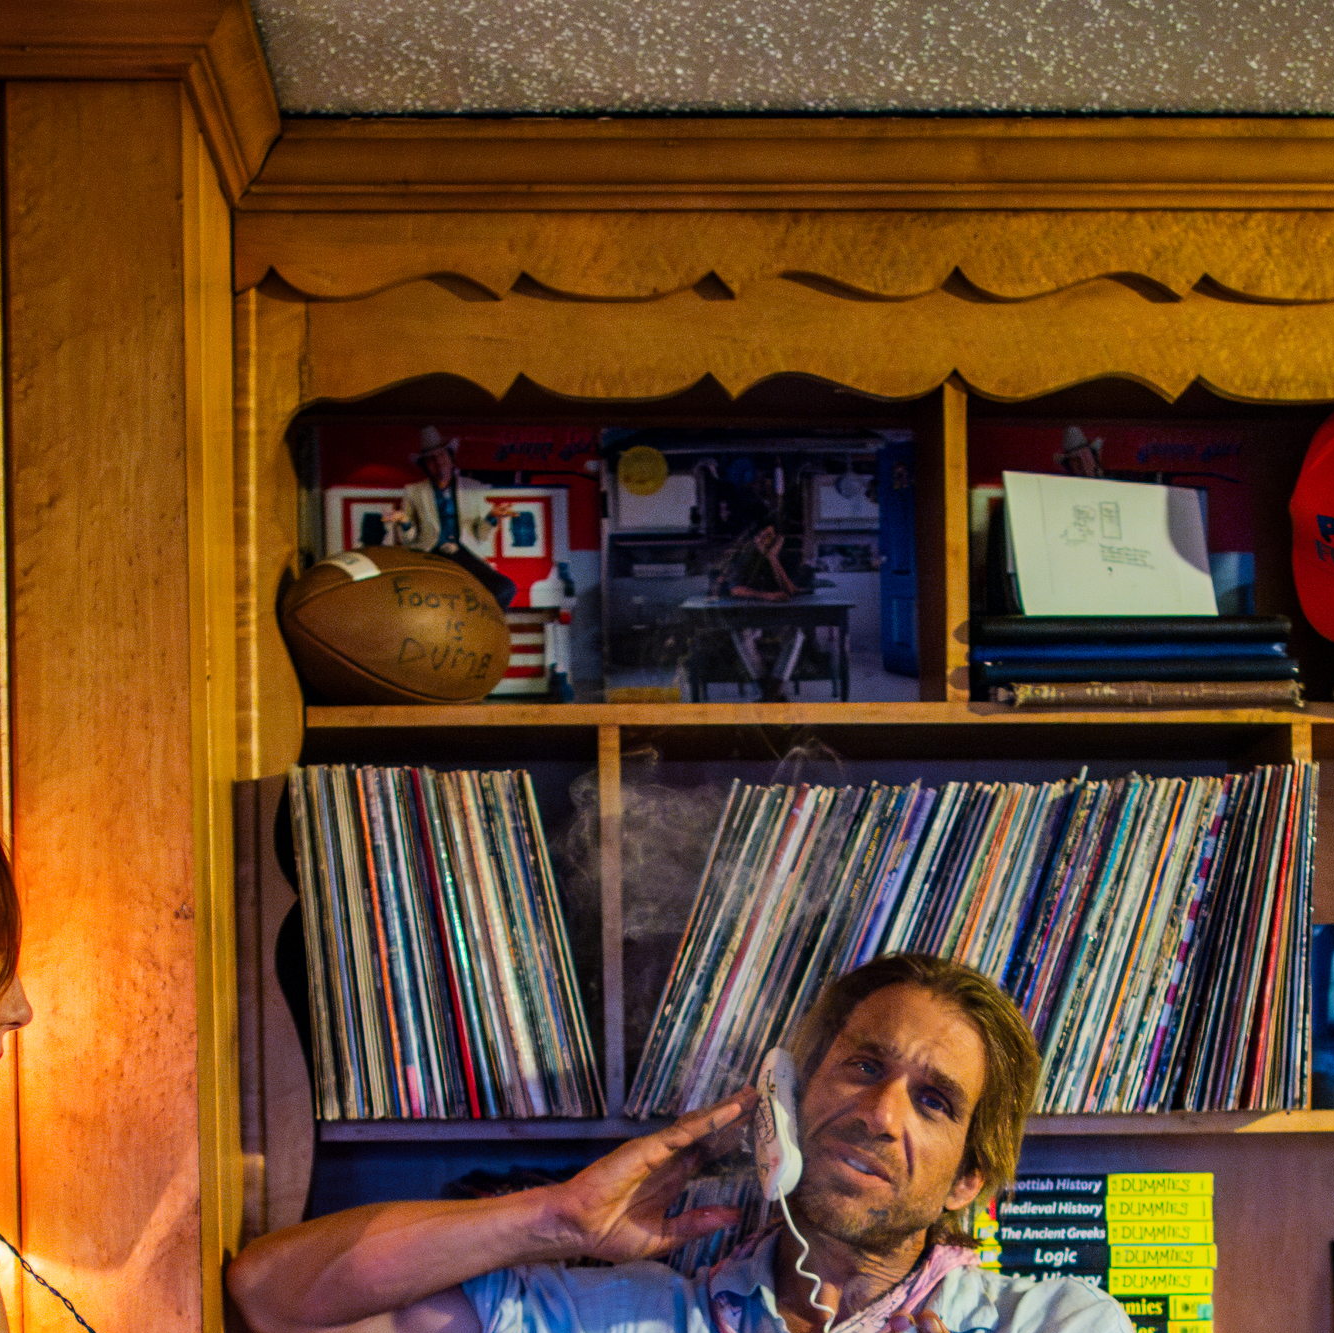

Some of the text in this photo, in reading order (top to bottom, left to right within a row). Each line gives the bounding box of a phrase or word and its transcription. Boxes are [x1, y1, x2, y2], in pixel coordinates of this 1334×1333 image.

[1056, 1179, 1103, 1194] History
[1121, 1178, 1191, 1195] DUMMIES
[1000, 1201, 1188, 1218] Medieval History DUMMIES
[1000, 1225, 1190, 1241] The Ancient Greeks DUMMIES
[1034, 1247, 1194, 1268] Logic DUMMIES
[1122, 1274, 1192, 1290] DUMMIES
